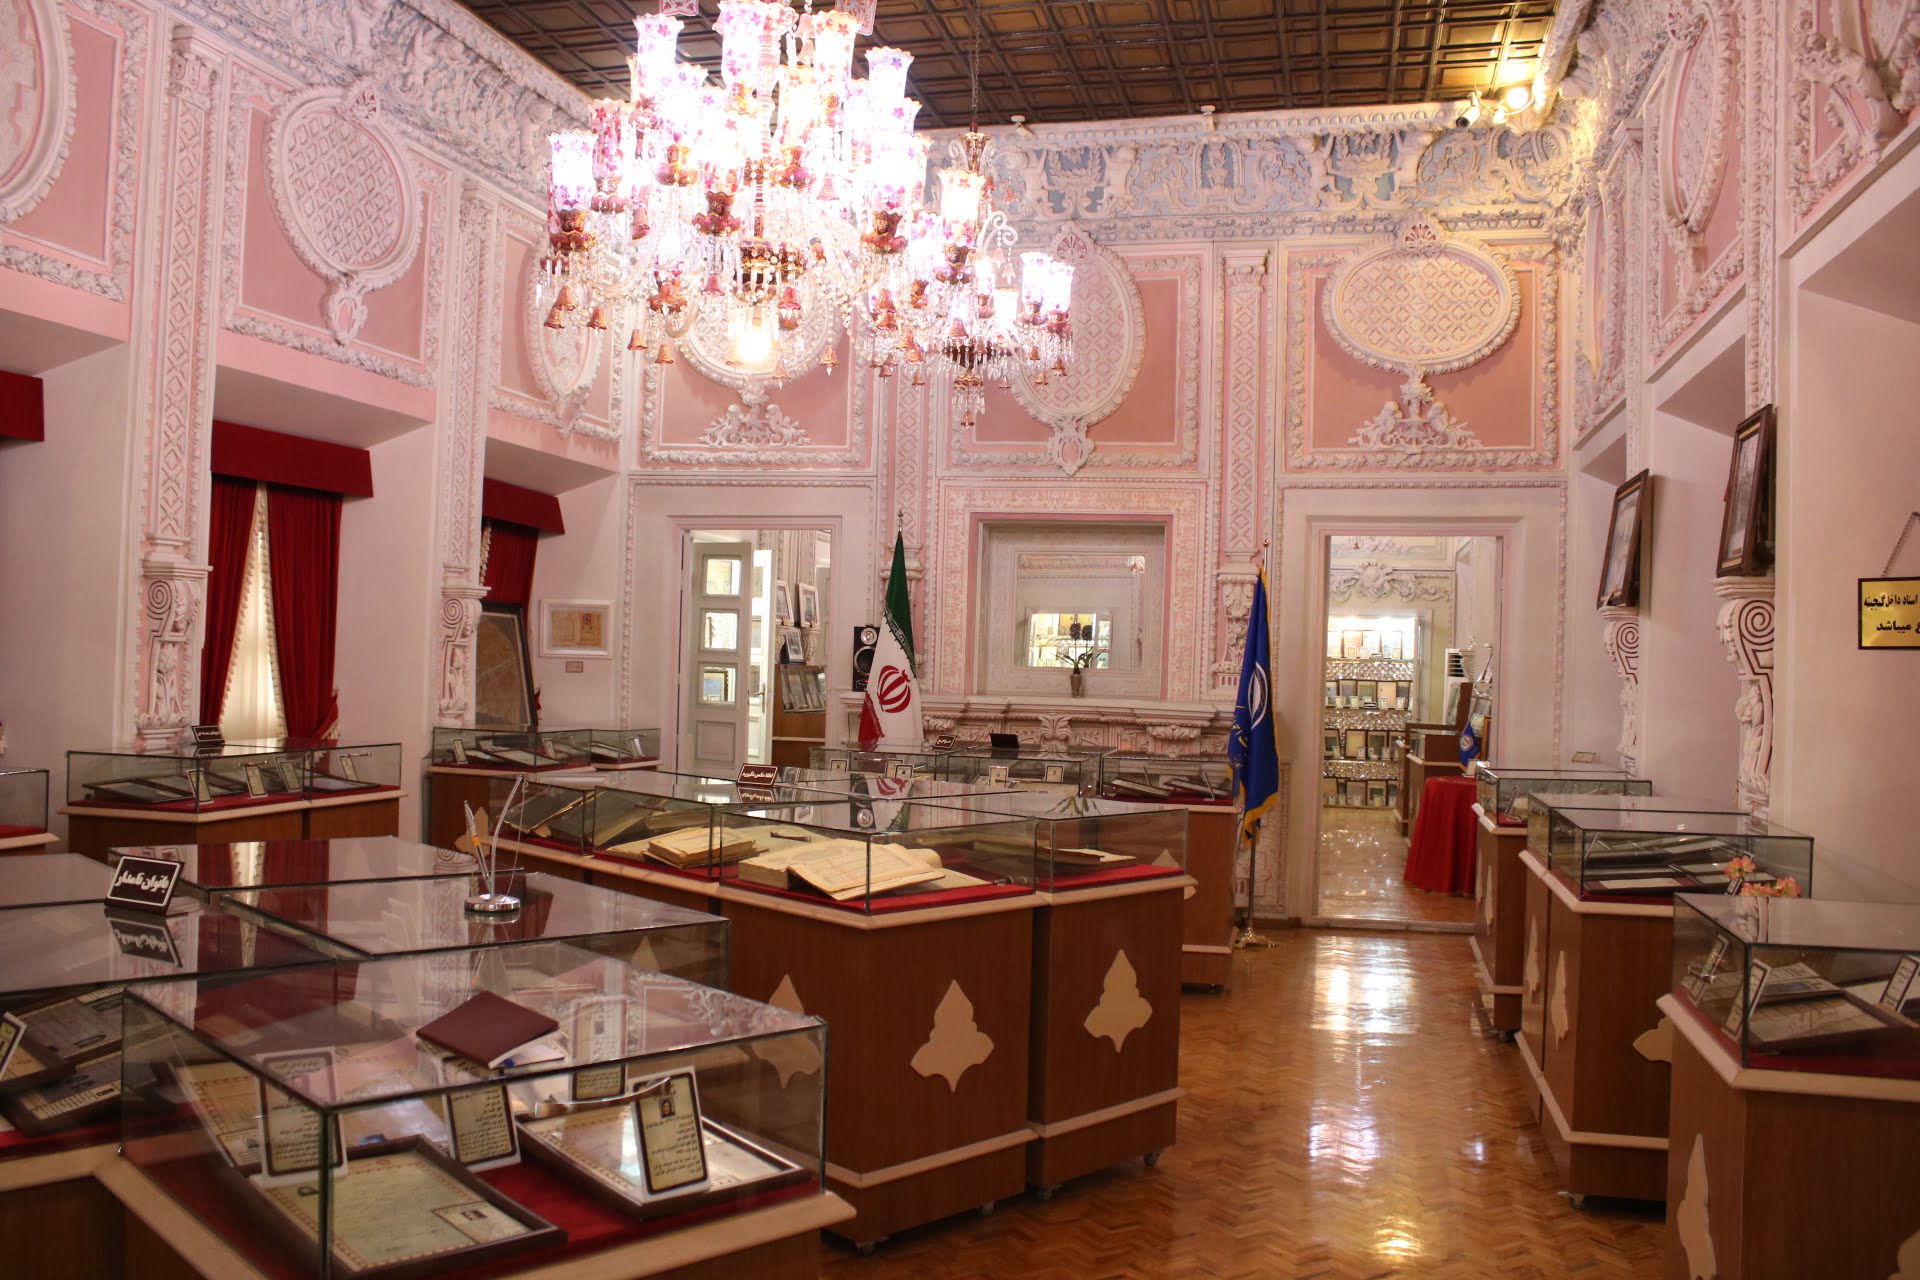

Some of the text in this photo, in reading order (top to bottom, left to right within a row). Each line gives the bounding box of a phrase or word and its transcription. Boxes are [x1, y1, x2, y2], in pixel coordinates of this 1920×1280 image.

[1864, 594, 1918, 611] اسناد داخل گنجینه
[1876, 620, 1912, 634] میباشد
[114, 870, 170, 893] بانوان نامدار
